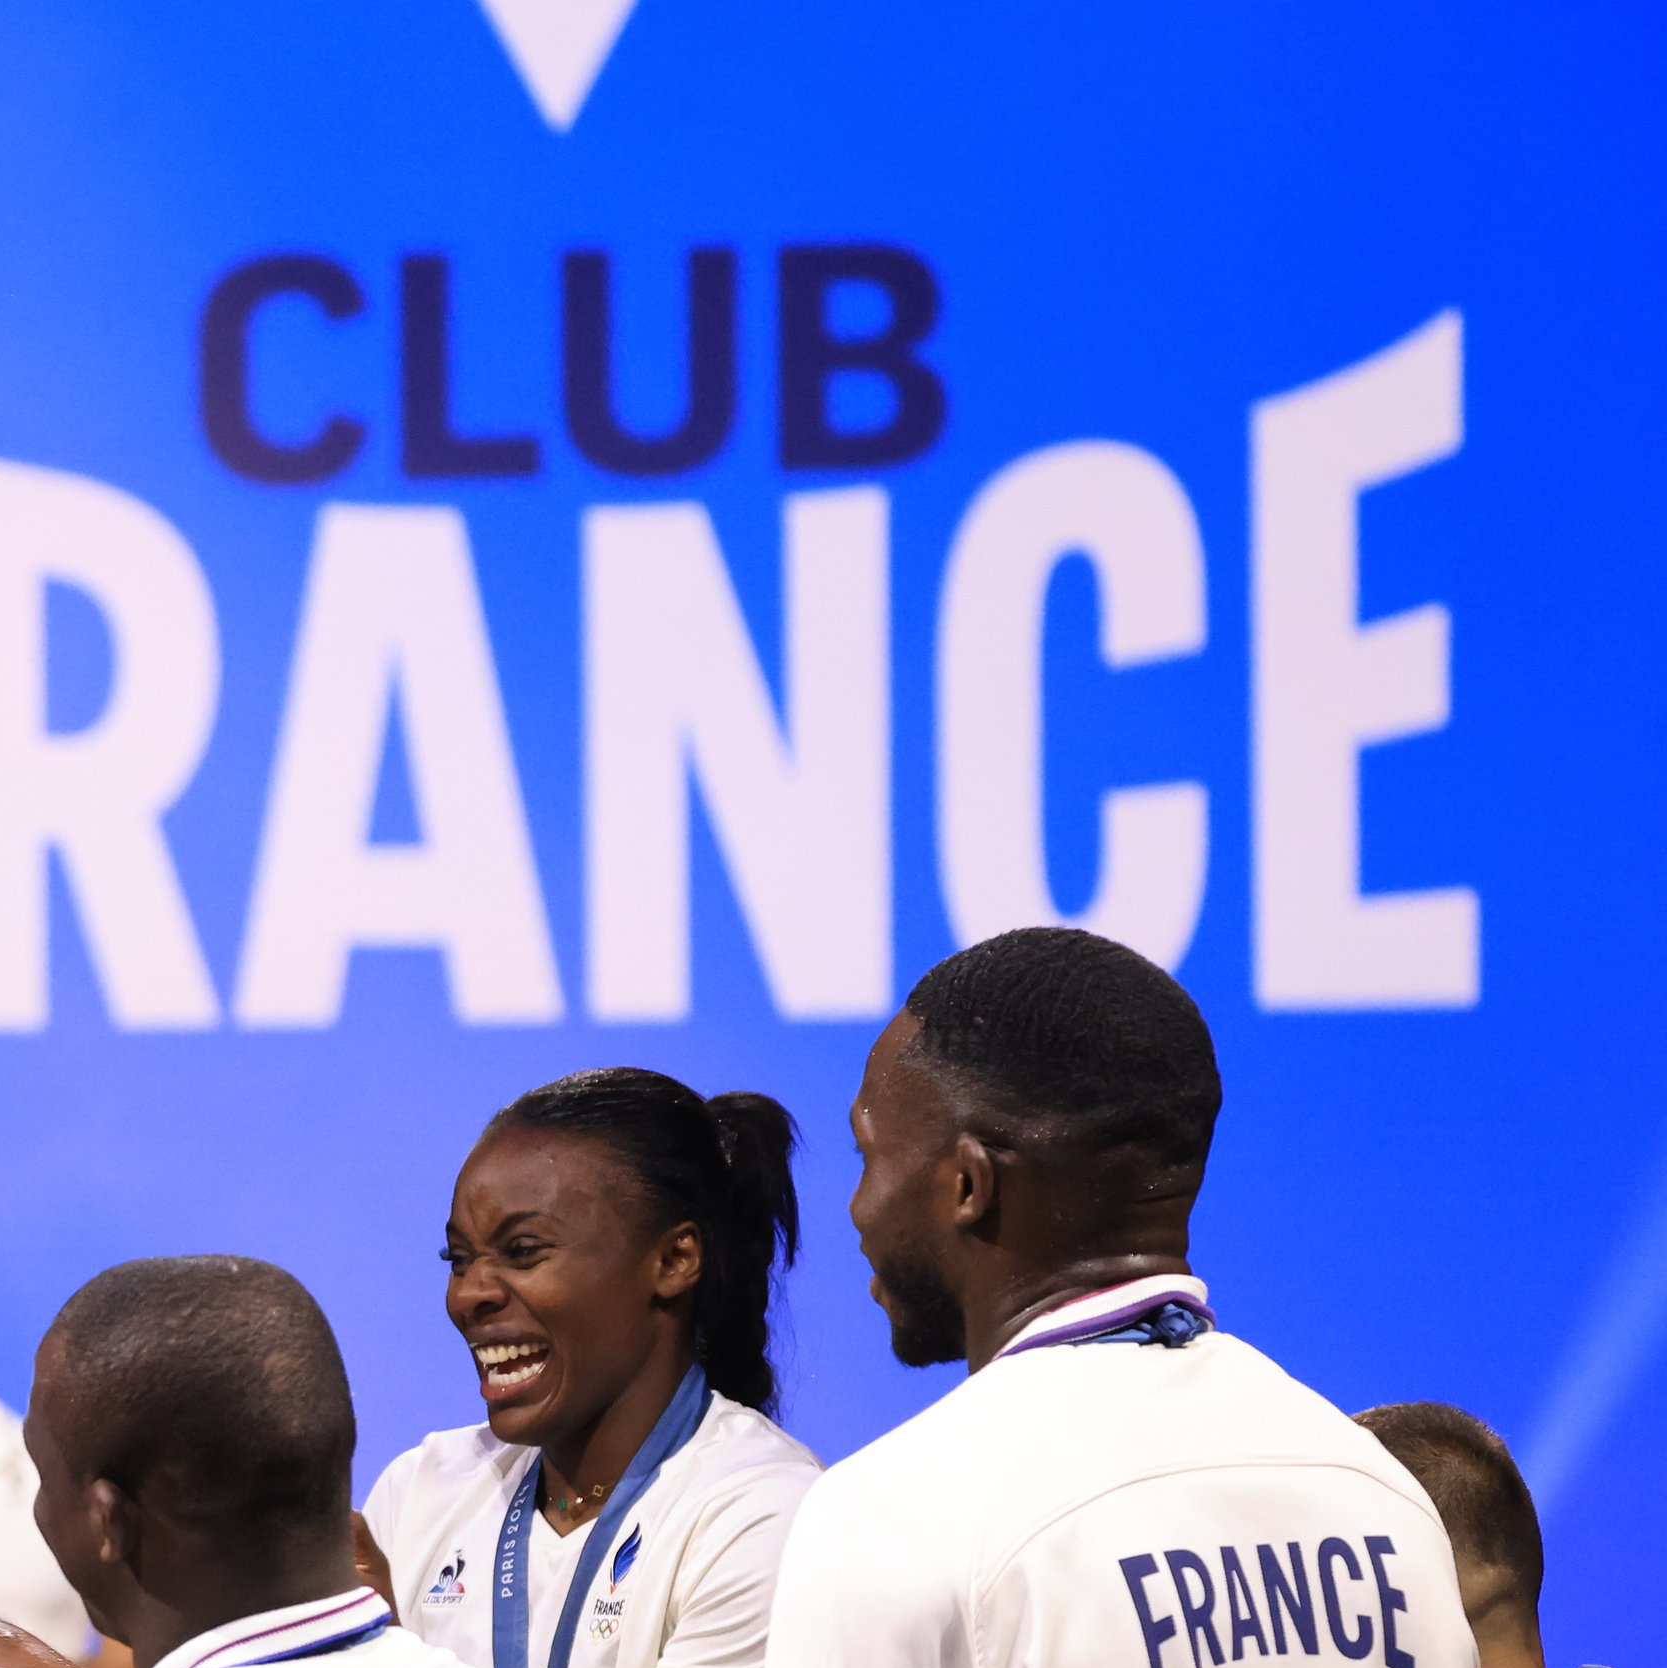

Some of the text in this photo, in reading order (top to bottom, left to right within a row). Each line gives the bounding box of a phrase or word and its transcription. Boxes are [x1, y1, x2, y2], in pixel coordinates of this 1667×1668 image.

[201, 246, 943, 485] CLUB
[501, 1539, 516, 1599] PARIS
[593, 1598, 625, 1616] FRANCE
